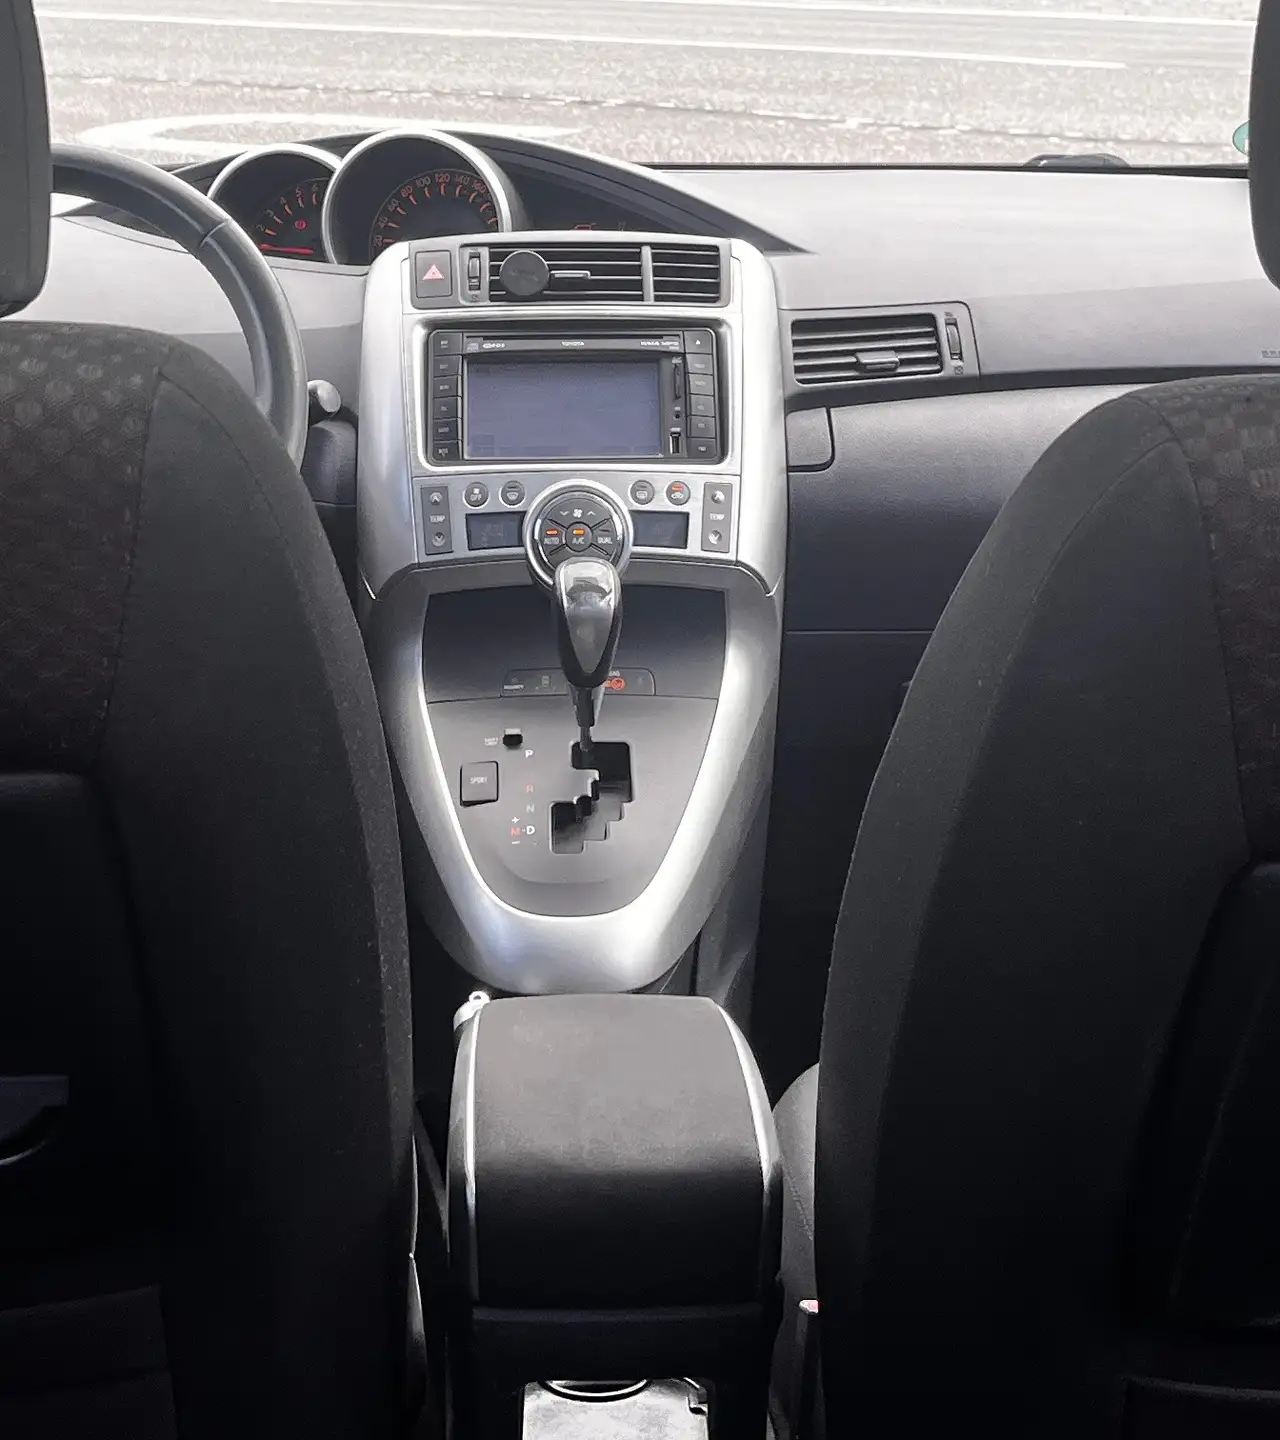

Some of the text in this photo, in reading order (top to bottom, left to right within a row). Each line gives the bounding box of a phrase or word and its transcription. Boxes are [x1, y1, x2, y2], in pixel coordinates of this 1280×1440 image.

[415, 175, 431, 188] 100
[434, 173, 451, 183] 120
[400, 184, 413, 198] 80
[571, 536, 585, 545] A/C
[597, 536, 613, 544] DUAL
[525, 749, 534, 758] P
[526, 804, 535, 813] N
[526, 825, 536, 835] D
